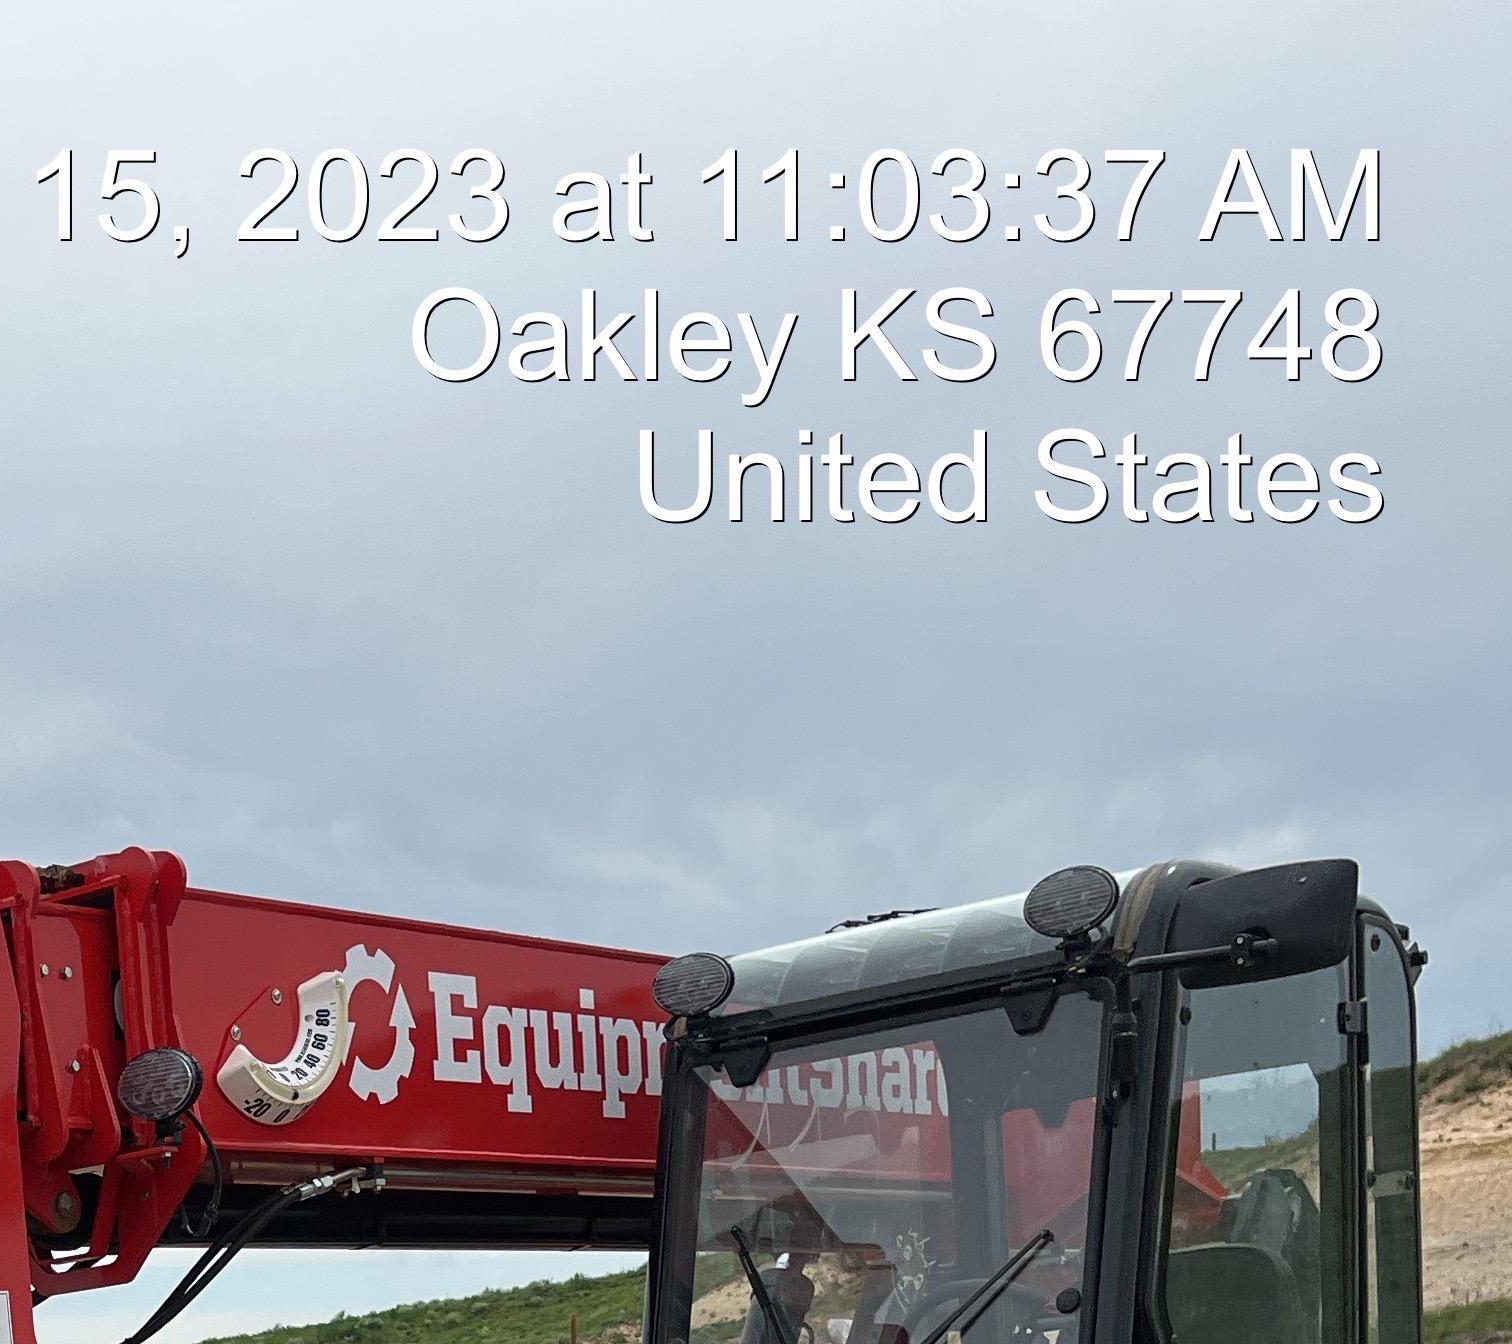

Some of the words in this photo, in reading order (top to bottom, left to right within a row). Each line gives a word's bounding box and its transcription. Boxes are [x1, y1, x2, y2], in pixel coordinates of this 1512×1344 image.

[315, 1008, 331, 1027] 80
[311, 1032, 329, 1051] 60
[303, 1053, 321, 1069] 40
[243, 1097, 272, 1119] -20
[273, 1108, 291, 1124] 0
